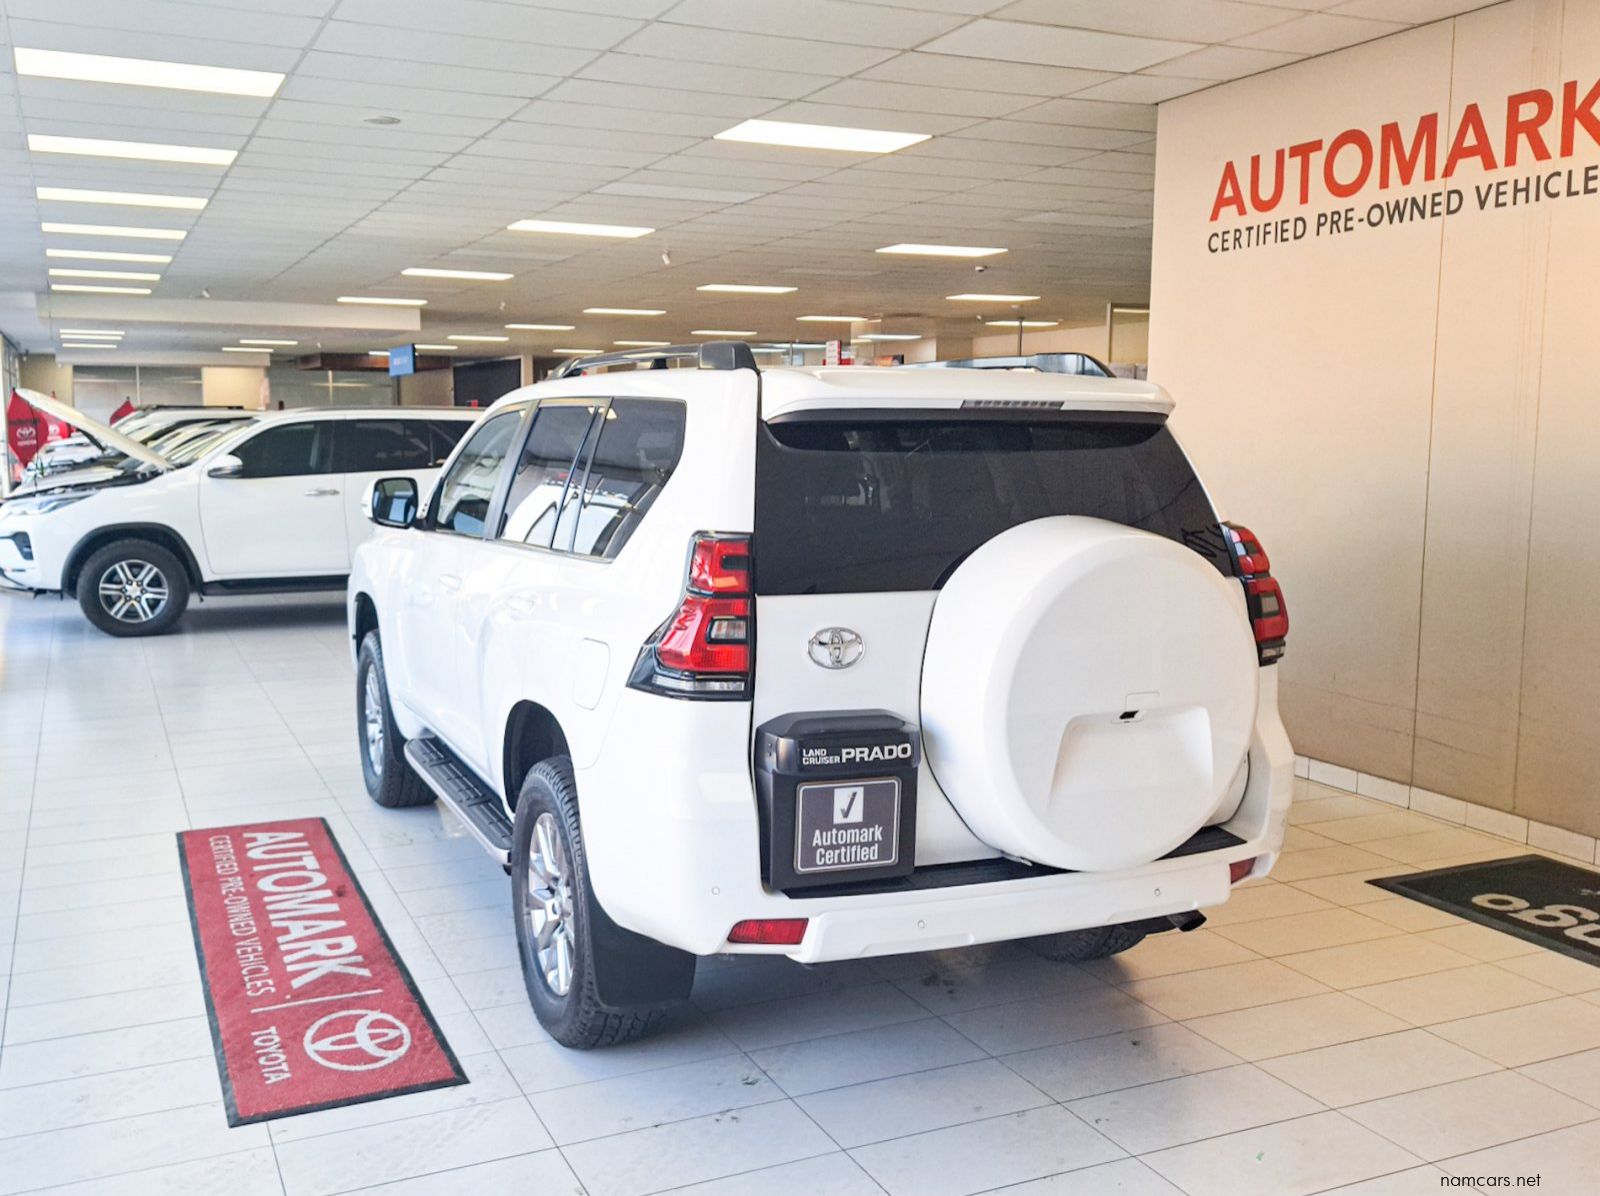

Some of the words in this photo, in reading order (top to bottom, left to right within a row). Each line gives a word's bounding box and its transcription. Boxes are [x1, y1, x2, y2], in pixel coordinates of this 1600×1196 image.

[1209, 76, 1600, 222] AUTOMARK
[1207, 215, 1307, 254] CERTIFIED
[1316, 188, 1464, 236] PRE-OWNED
[802, 748, 827, 757] LAND
[802, 756, 841, 765] CRUISER
[841, 743, 912, 763] PRADO
[208, 834, 240, 875] CERTIFIED
[812, 824, 883, 847] Automark
[815, 844, 879, 865] Certified
[219, 876, 257, 936] PRE-OWNED
[242, 831, 373, 990] AUTOMARK
[235, 937, 276, 997] VEHICLES
[251, 1025, 292, 1085] TOYOTA
